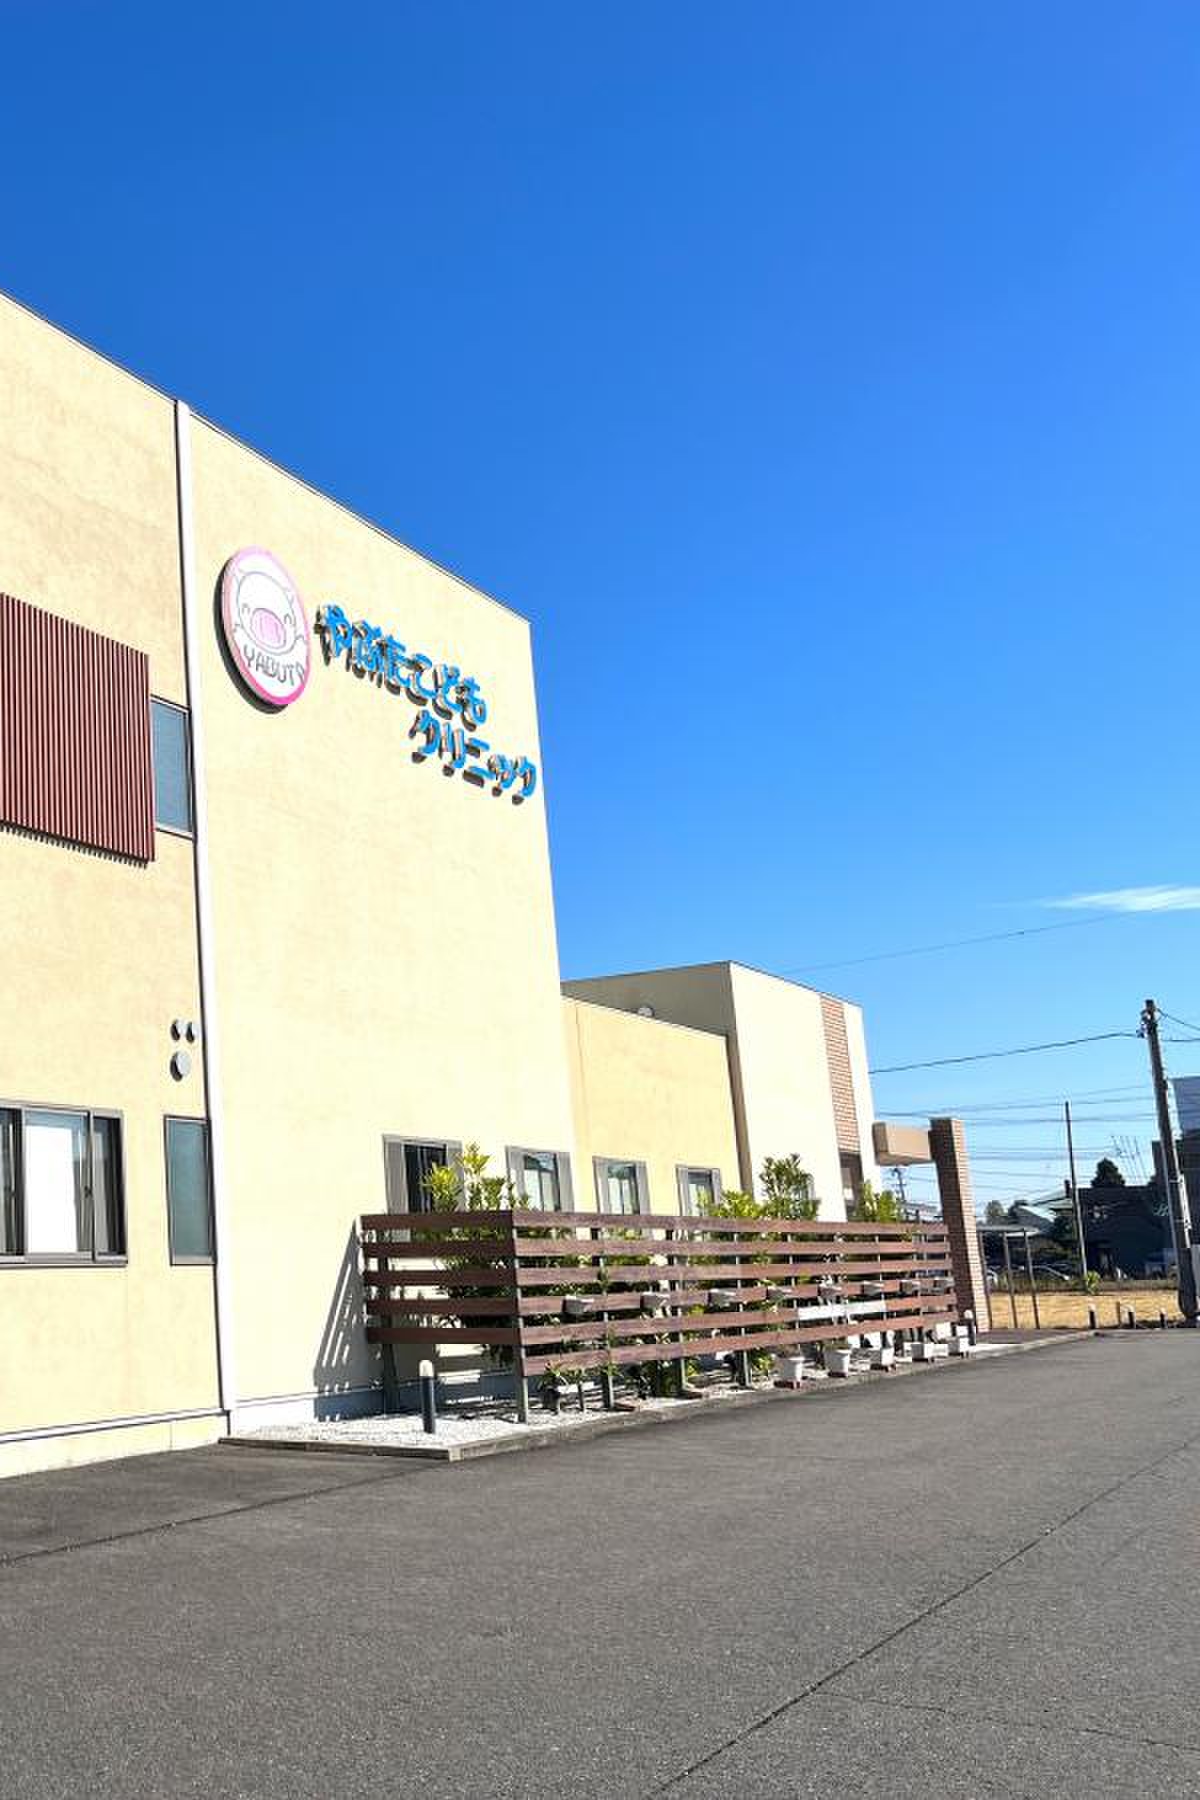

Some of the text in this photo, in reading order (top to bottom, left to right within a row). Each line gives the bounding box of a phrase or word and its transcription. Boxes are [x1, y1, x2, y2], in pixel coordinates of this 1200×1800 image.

[317, 604, 487, 724] やぶたこども
[412, 709, 537, 798] クリニック
